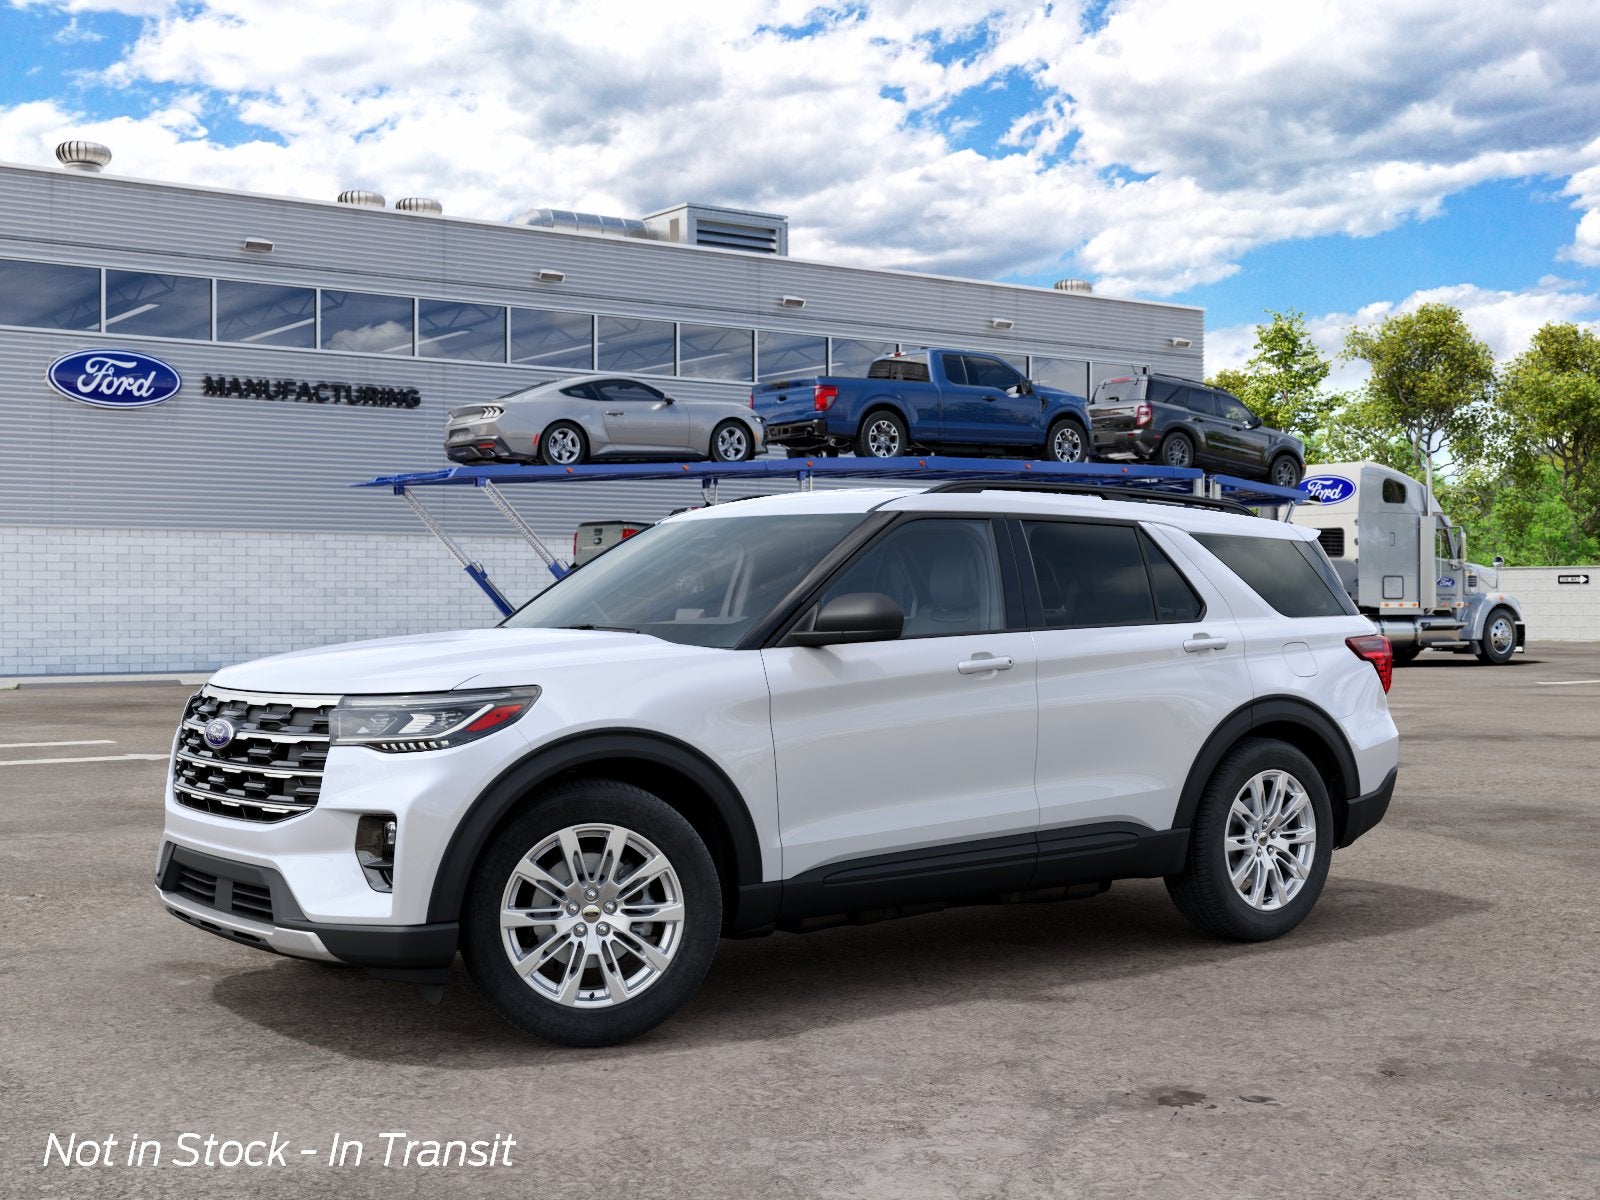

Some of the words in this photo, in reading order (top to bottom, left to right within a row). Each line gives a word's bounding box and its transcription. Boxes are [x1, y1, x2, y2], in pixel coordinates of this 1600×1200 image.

[76, 356, 157, 398] Ford
[202, 374, 421, 408] MANUFACTURING
[1306, 479, 1343, 500] Ford
